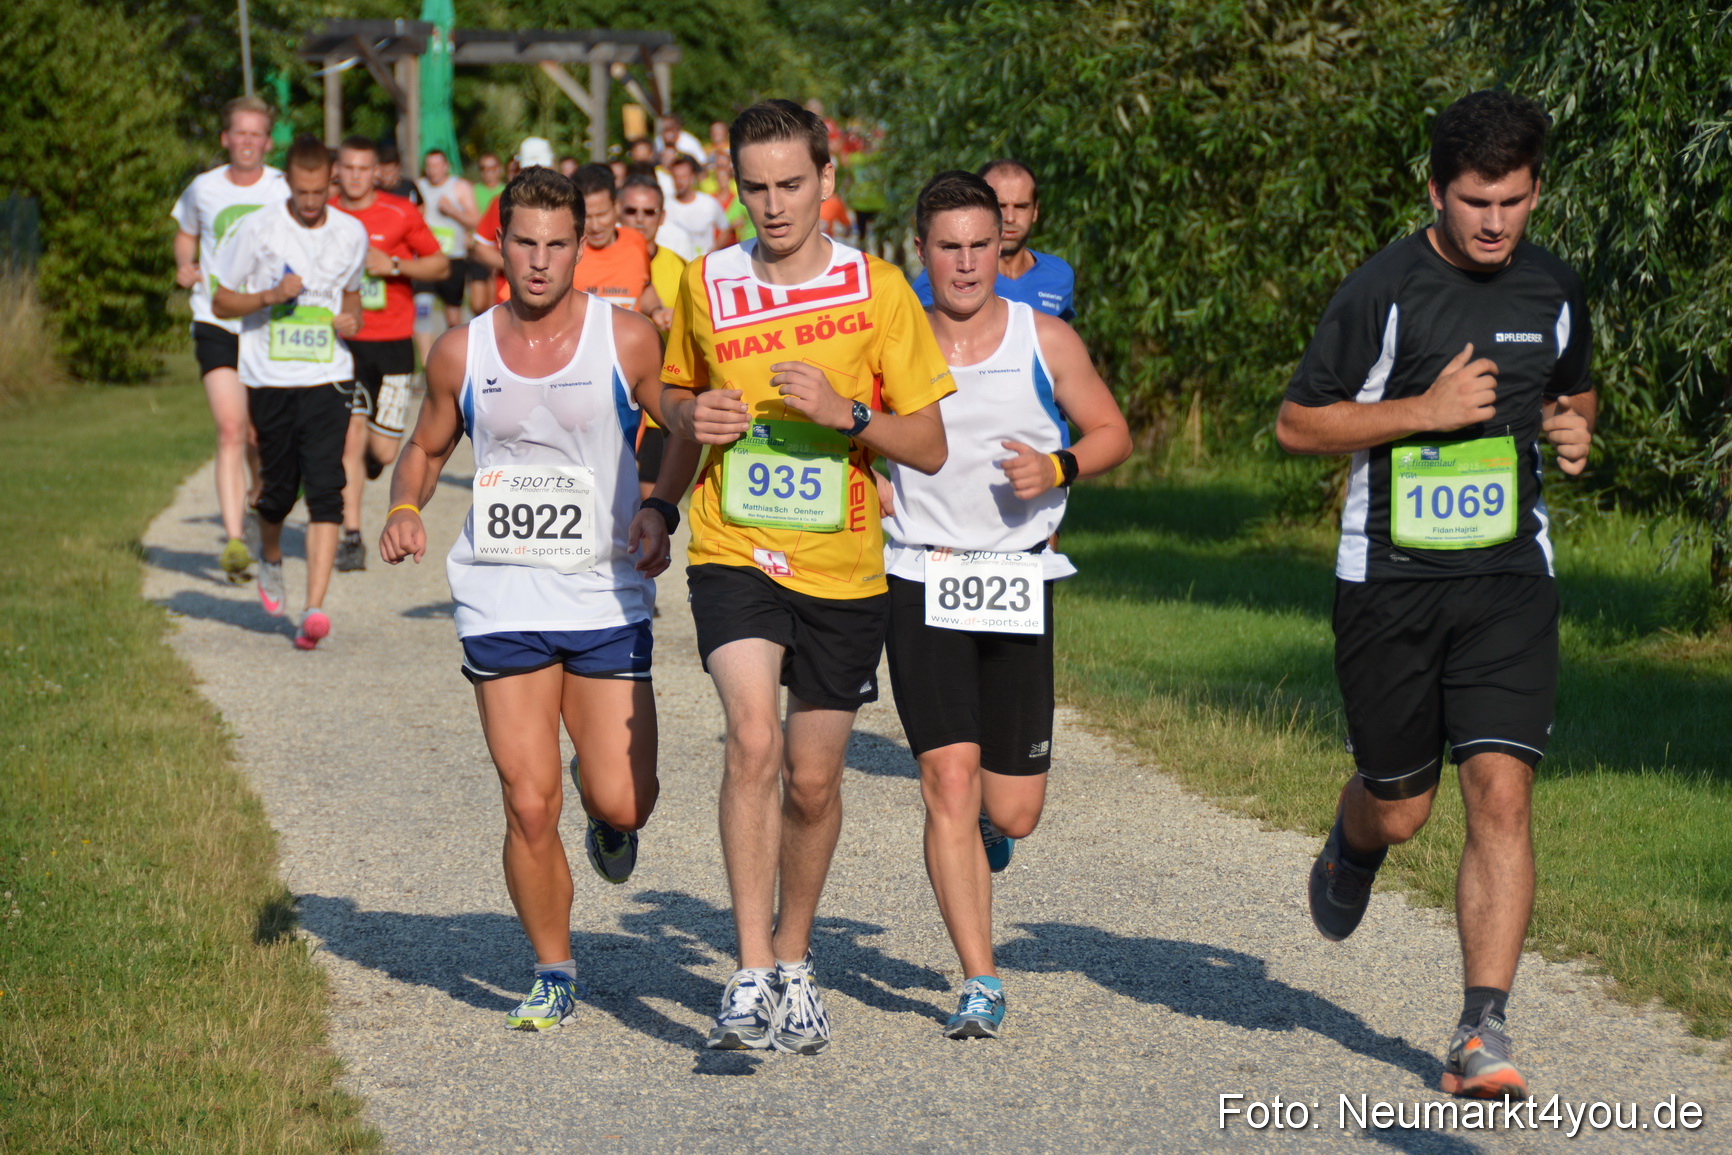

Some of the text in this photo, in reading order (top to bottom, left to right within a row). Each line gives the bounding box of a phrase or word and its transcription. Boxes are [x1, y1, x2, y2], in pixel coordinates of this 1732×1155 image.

[277, 328, 328, 348] 1465
[714, 311, 873, 364] MAX BÖGL
[1504, 333, 1543, 343] PFLEIDERER
[1412, 458, 1456, 468] firmenlauf
[479, 470, 575, 490] df-sports
[748, 462, 822, 500] 935
[551, 487, 589, 495] Zeitmessung
[1406, 482, 1504, 519] 1069
[742, 503, 824, 515] Matthias Sch Oenherr
[487, 503, 582, 540] 8922
[1454, 526, 1478, 534] Hajrizi
[479, 546, 591, 556] www.df-sports.de
[938, 576, 1031, 612] 8923
[931, 615, 1039, 627] www.df-sports.de
